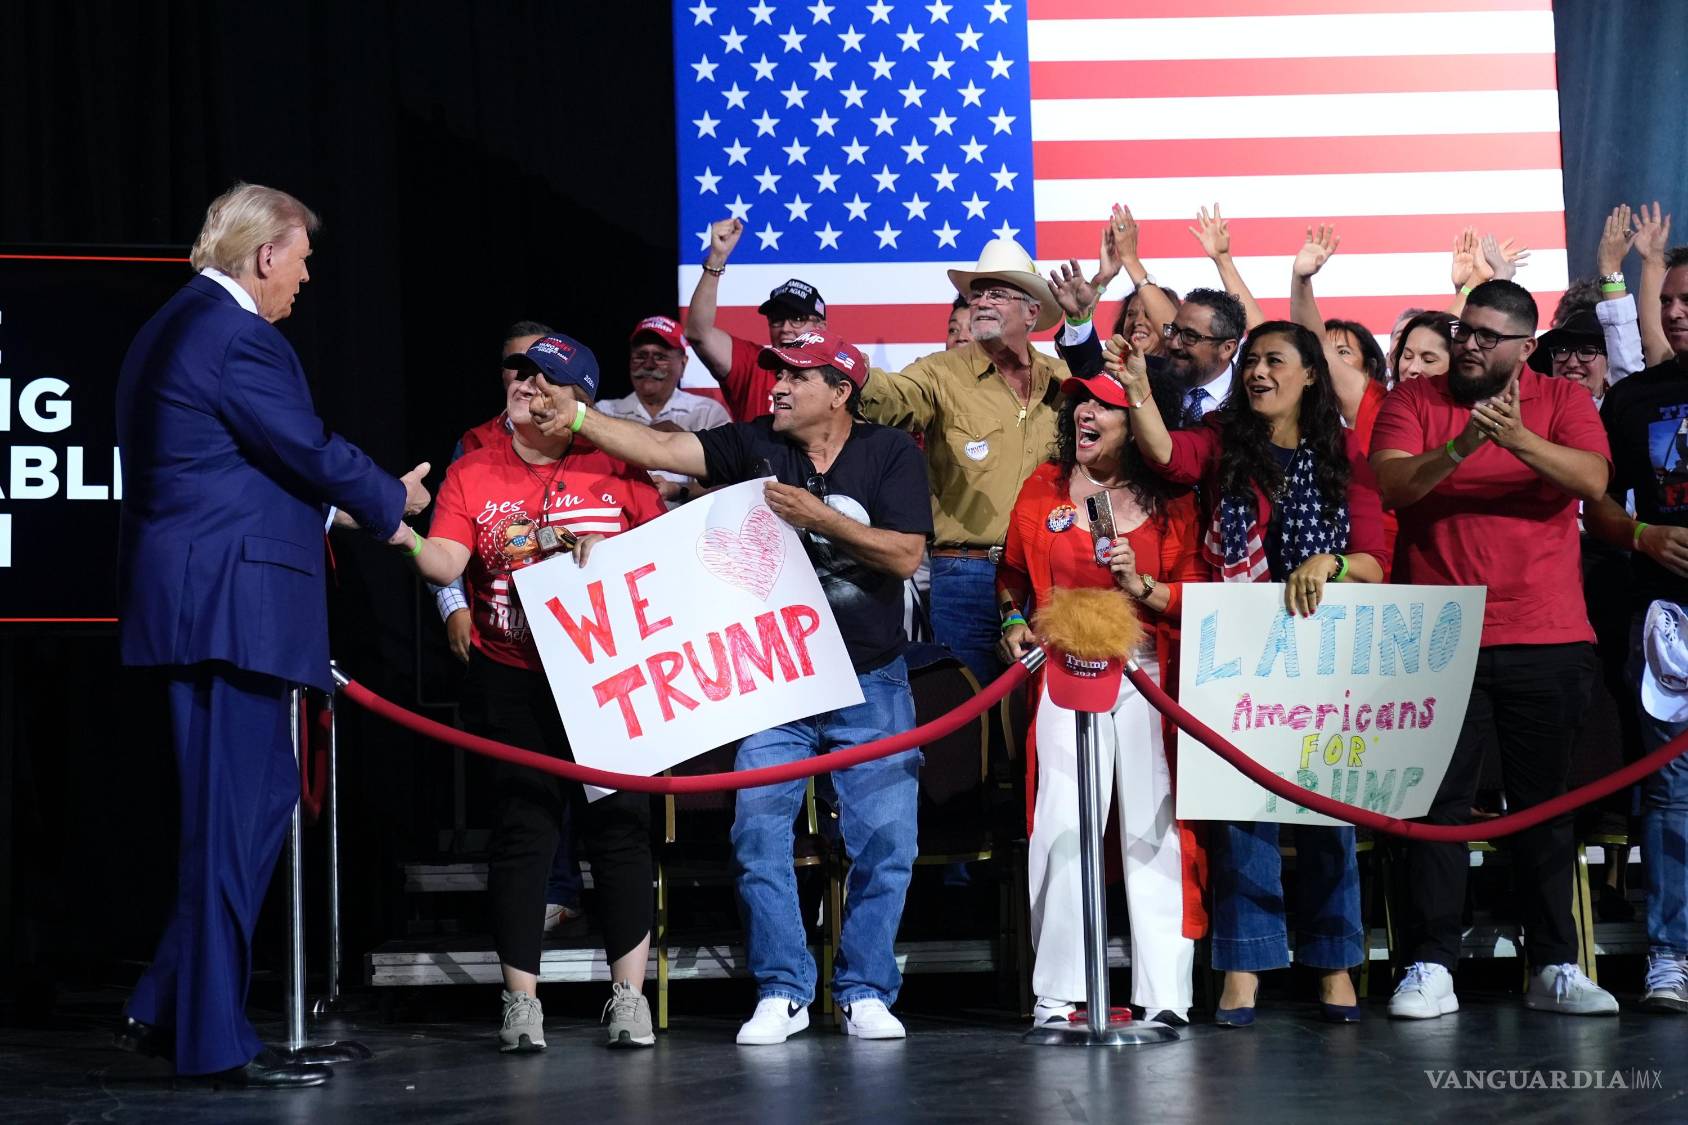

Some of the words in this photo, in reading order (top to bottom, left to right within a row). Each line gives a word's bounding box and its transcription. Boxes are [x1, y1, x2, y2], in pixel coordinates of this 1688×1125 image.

[476, 499, 525, 524] yes
[601, 493, 617, 504] a
[545, 562, 673, 664] WE
[1065, 652, 1109, 670] Trump
[1195, 601, 1462, 687] LATINO
[592, 604, 820, 739] TRUMP
[1231, 689, 1437, 733] Americans
[1299, 733, 1367, 769] FOR
